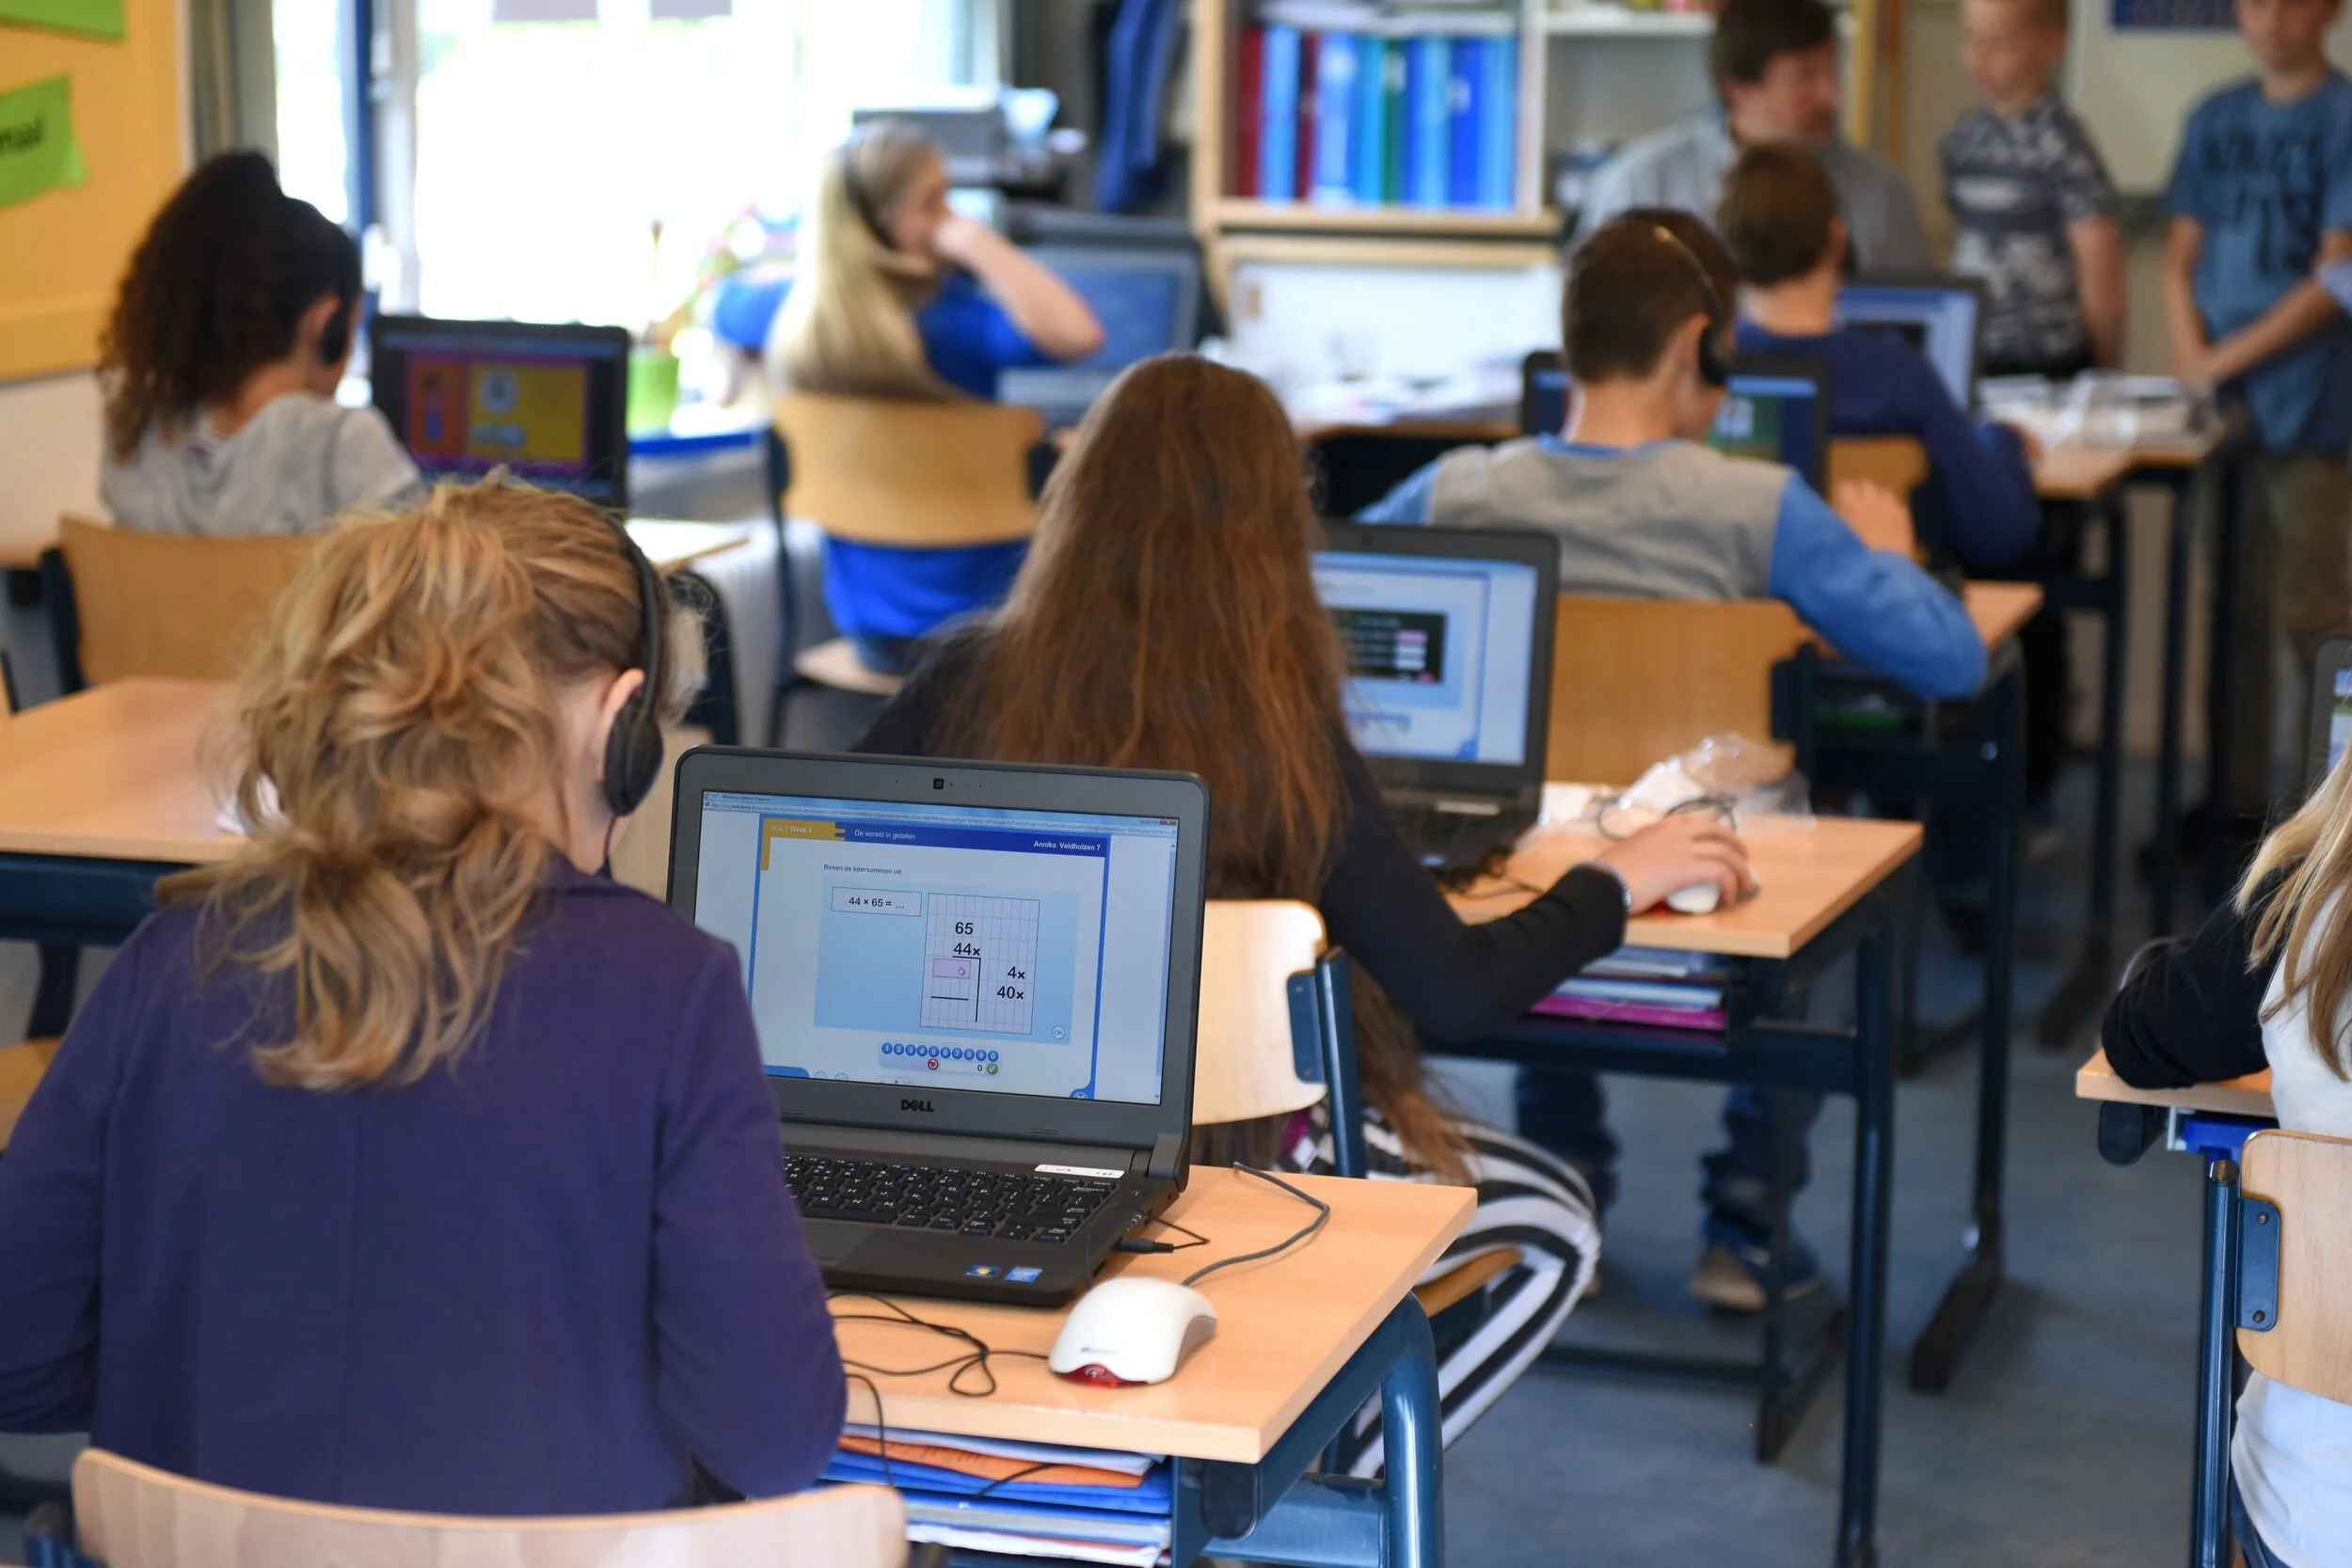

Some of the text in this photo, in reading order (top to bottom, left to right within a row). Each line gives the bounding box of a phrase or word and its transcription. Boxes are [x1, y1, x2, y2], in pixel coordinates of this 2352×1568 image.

[1059, 842, 1095, 851] Veldhuizen
[853, 866, 892, 874] keersommen
[849, 897, 861, 906] 44
[872, 898, 883, 907] 65
[955, 922, 973, 935] 65
[901, 1099, 934, 1112] DELL
